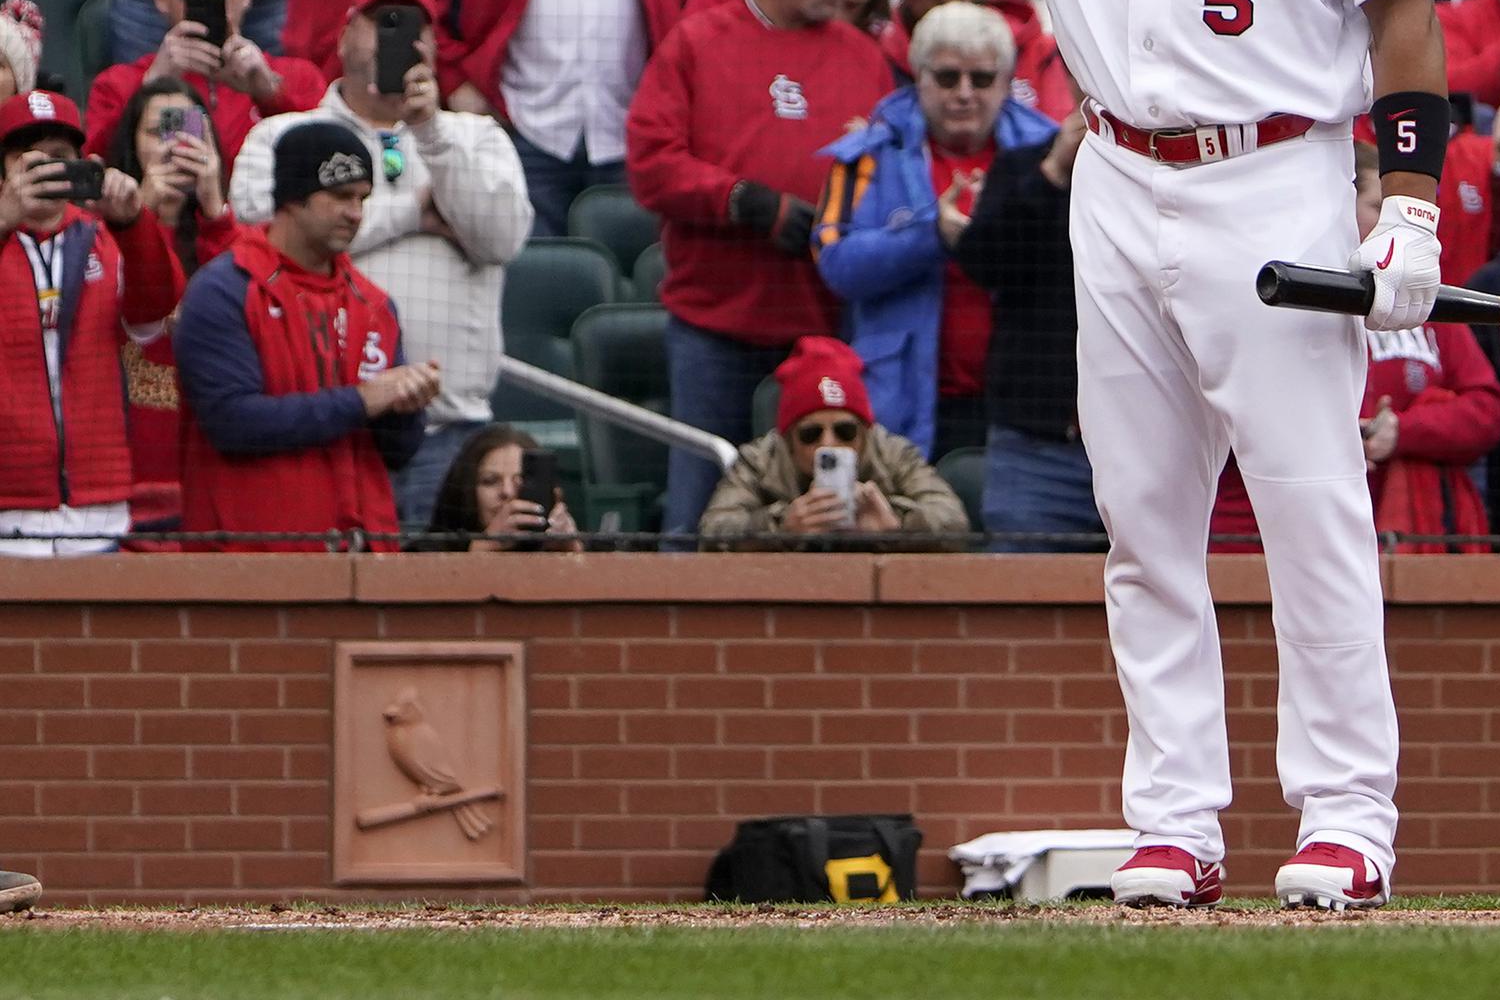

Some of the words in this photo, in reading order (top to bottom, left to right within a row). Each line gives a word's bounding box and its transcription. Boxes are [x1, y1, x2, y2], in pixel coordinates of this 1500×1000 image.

[1397, 120, 1417, 152] 5
[1205, 137, 1215, 156] 5
[1407, 206, 1436, 222] PUJOLS
